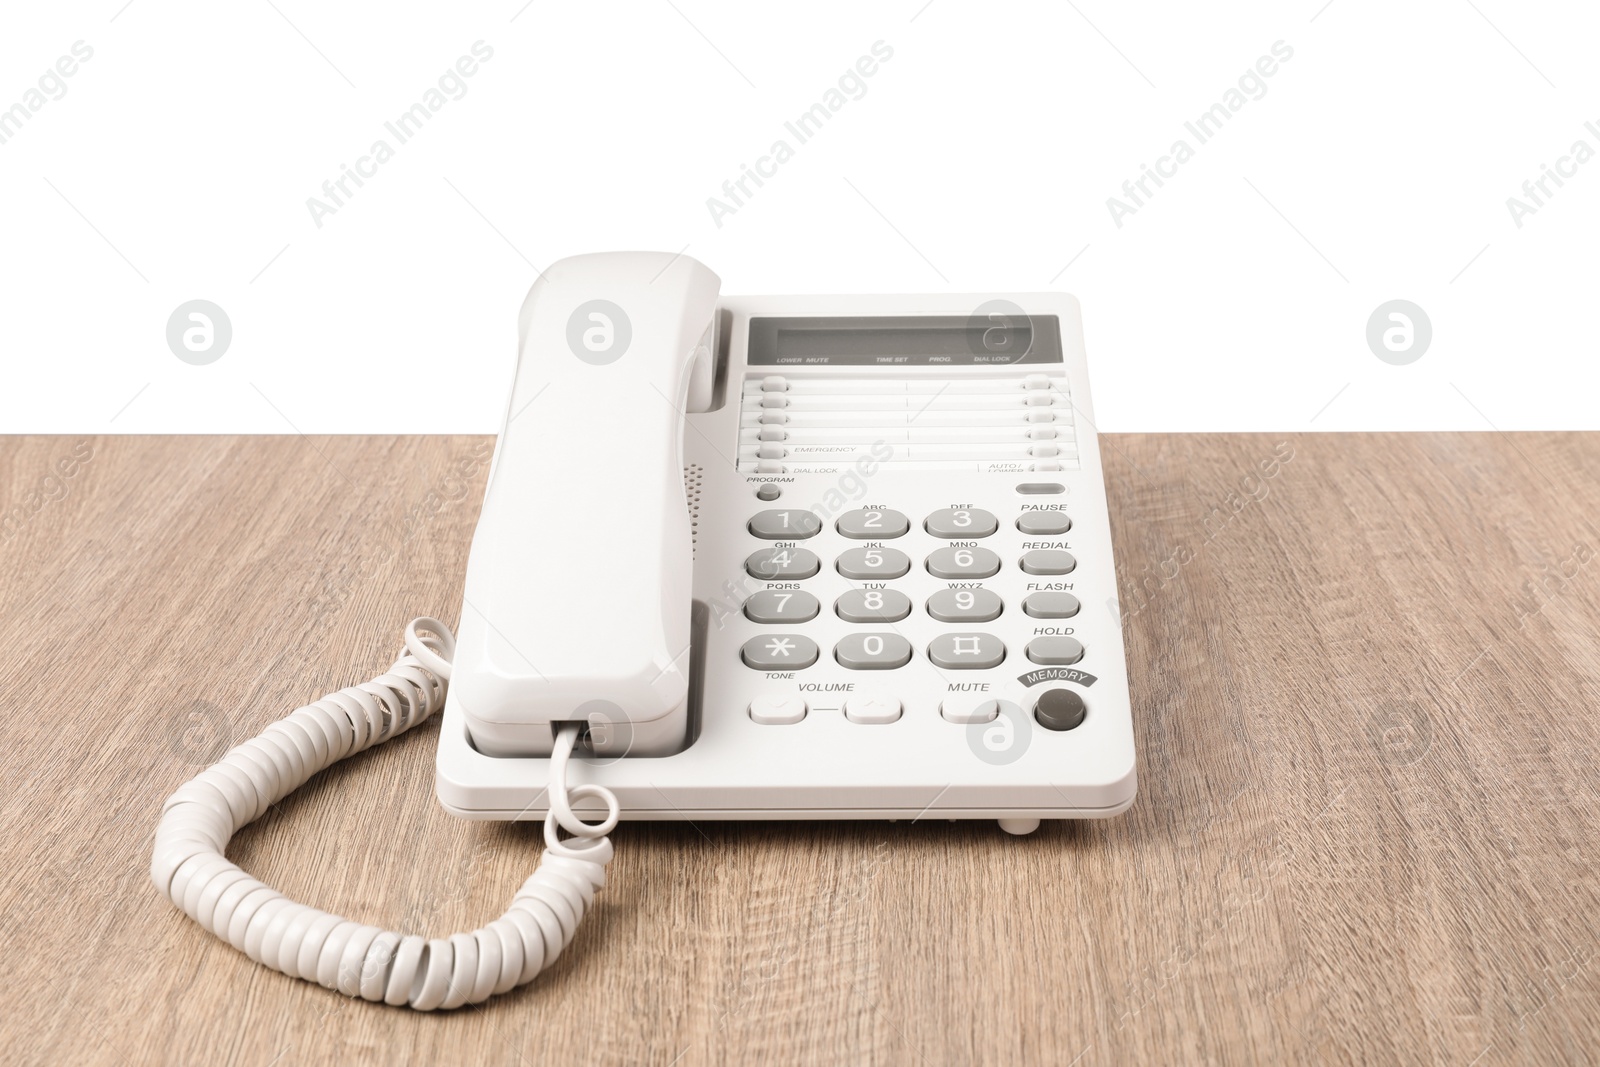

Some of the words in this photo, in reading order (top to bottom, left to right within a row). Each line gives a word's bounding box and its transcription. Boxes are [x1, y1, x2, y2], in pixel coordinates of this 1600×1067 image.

[777, 511, 789, 528] 1
[863, 511, 883, 528] 2
[952, 510, 972, 527] 3
[1021, 541, 1072, 549] REDIAL
[771, 550, 791, 568] 4
[864, 550, 883, 567] 5
[954, 549, 974, 567] 6
[773, 593, 793, 613] 7
[863, 591, 884, 610] 8
[955, 591, 975, 610] 9
[1033, 627, 1075, 635] HOLD
[765, 672, 796, 680] TONE
[1026, 669, 1089, 684] MEMORY
[798, 683, 855, 692] VOLUME
[947, 683, 991, 692] MUTE
